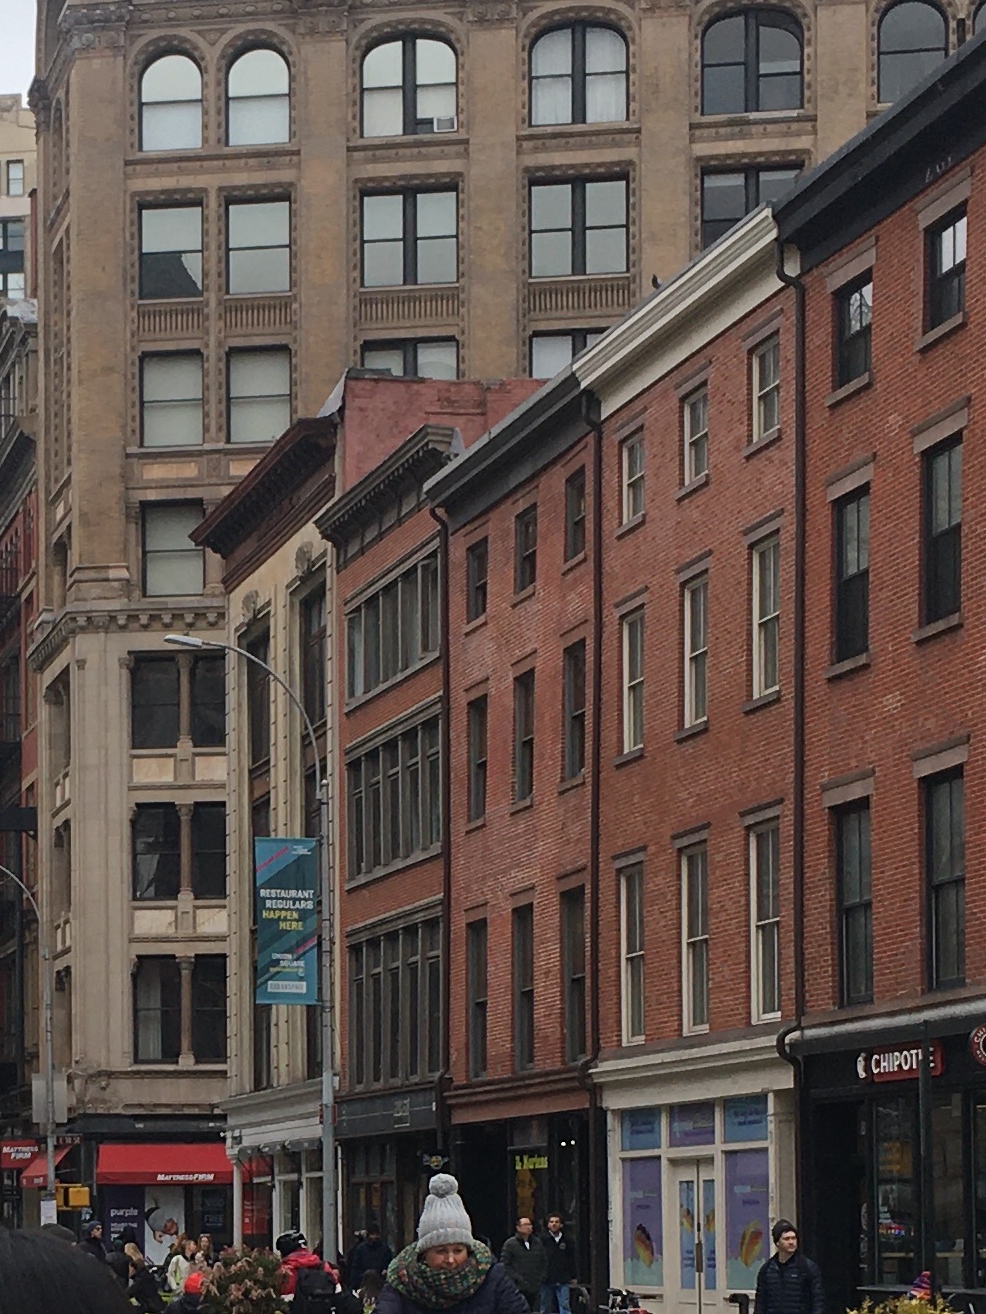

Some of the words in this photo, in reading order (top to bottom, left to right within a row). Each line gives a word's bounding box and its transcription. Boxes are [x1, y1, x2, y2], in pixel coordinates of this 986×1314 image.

[260, 889, 314, 899] RESTAURANT
[266, 900, 314, 909] REGULARS
[263, 910, 298, 919] HAPPEN
[279, 921, 304, 930] HERE
